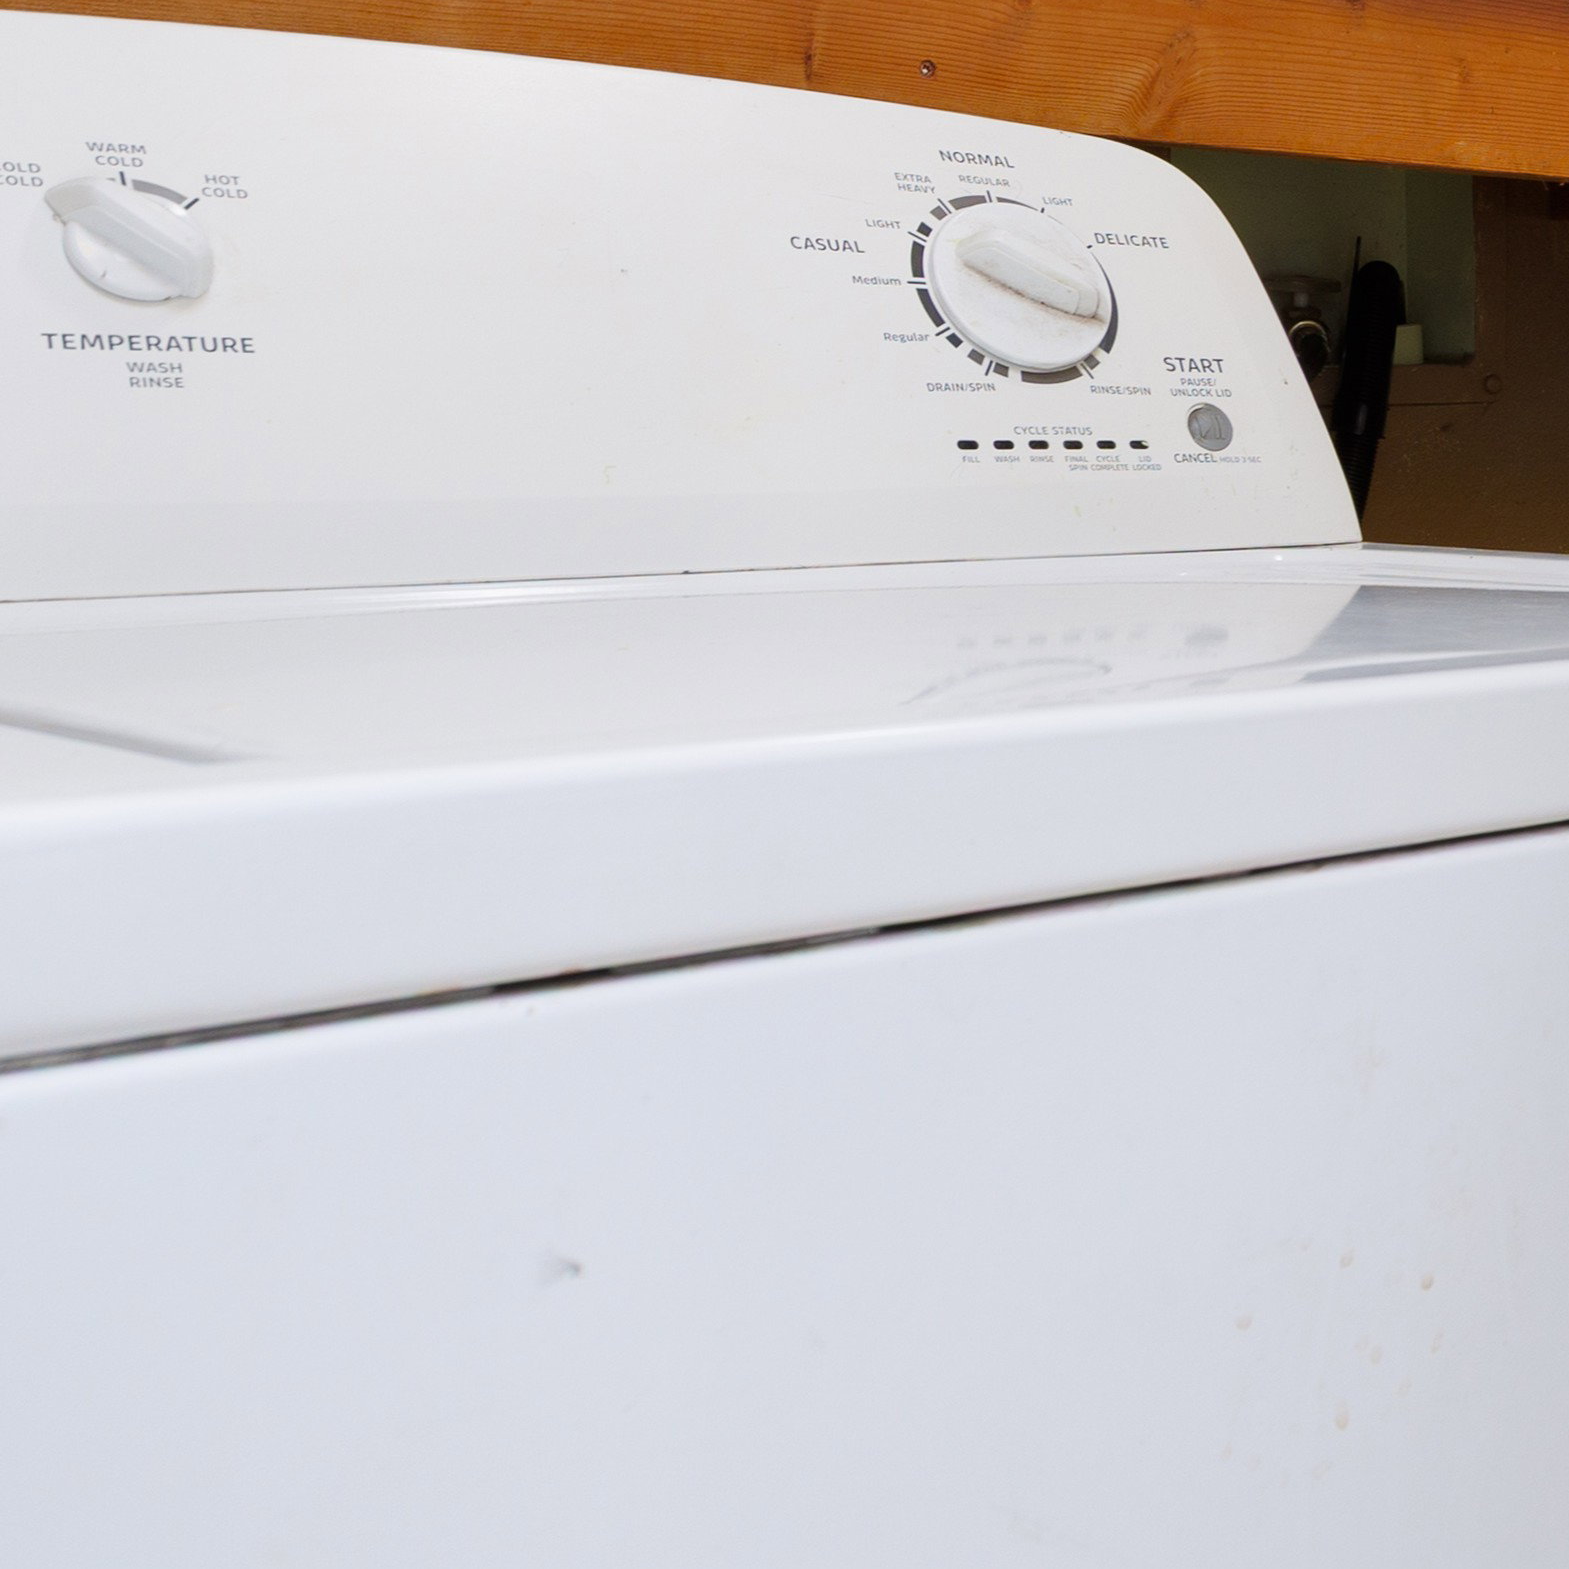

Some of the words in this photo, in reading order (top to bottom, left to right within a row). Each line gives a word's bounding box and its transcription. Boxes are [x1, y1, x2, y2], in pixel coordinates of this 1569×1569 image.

[85, 141, 147, 154] WARM
[95, 155, 144, 168] COLD
[938, 149, 1016, 169] NORMAL
[204, 174, 240, 186] HOT
[894, 171, 932, 184] EXTRA
[958, 174, 1011, 188] REGULAR
[201, 186, 249, 199] COLD
[897, 183, 936, 195] HEAVY
[1042, 196, 1074, 207] LIGHT
[865, 218, 902, 229] LIGHT
[790, 236, 866, 254] CASUAL
[1094, 231, 1170, 250] DELICATE
[851, 274, 901, 286] Medium
[41, 332, 256, 354] TEMPERATURE
[883, 332, 930, 344] Regular
[126, 361, 183, 374] WASH
[1163, 356, 1224, 373] START
[129, 376, 185, 389] RINSE
[926, 382, 996, 392] DRAIN/SPIN
[1180, 377, 1217, 386] PAUSE/
[1090, 385, 1152, 396] RINSE/SPIN
[1170, 388, 1214, 398] UNLOCK
[1215, 388, 1233, 398] LID
[1013, 425, 1049, 436] CYCLE
[1052, 426, 1094, 436] STATUS
[962, 455, 980, 463] FILL
[994, 455, 1020, 463] WASH
[1029, 455, 1055, 463] RINSE
[1064, 455, 1088, 463] FINAL
[1095, 455, 1121, 463] CYCLE
[1138, 455, 1152, 463] LID
[1173, 452, 1218, 464] CANCEL
[1219, 455, 1240, 463] HOLD
[1069, 464, 1089, 472] SPIN
[1090, 464, 1129, 472] COMPLETE
[1132, 463, 1162, 472] LOCKED
